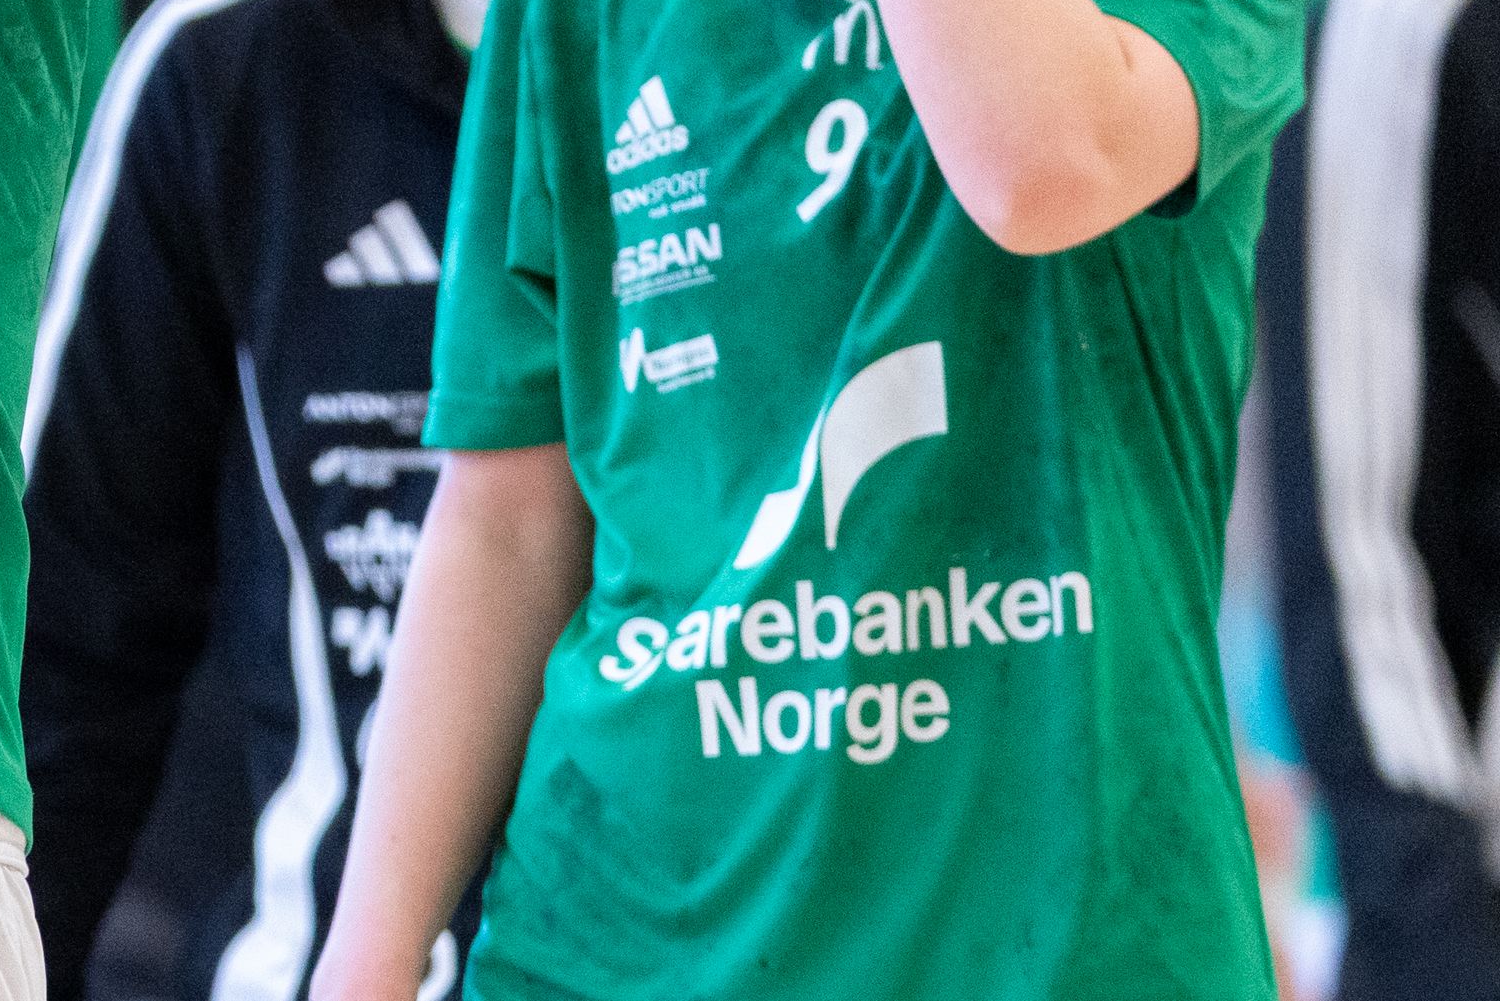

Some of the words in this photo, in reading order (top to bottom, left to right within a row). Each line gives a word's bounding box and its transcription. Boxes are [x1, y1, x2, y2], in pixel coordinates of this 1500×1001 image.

[606, 124, 690, 175] adidas
[796, 98, 869, 223] 9
[599, 566, 1094, 691] Sarebanken
[695, 676, 951, 765] Norge
